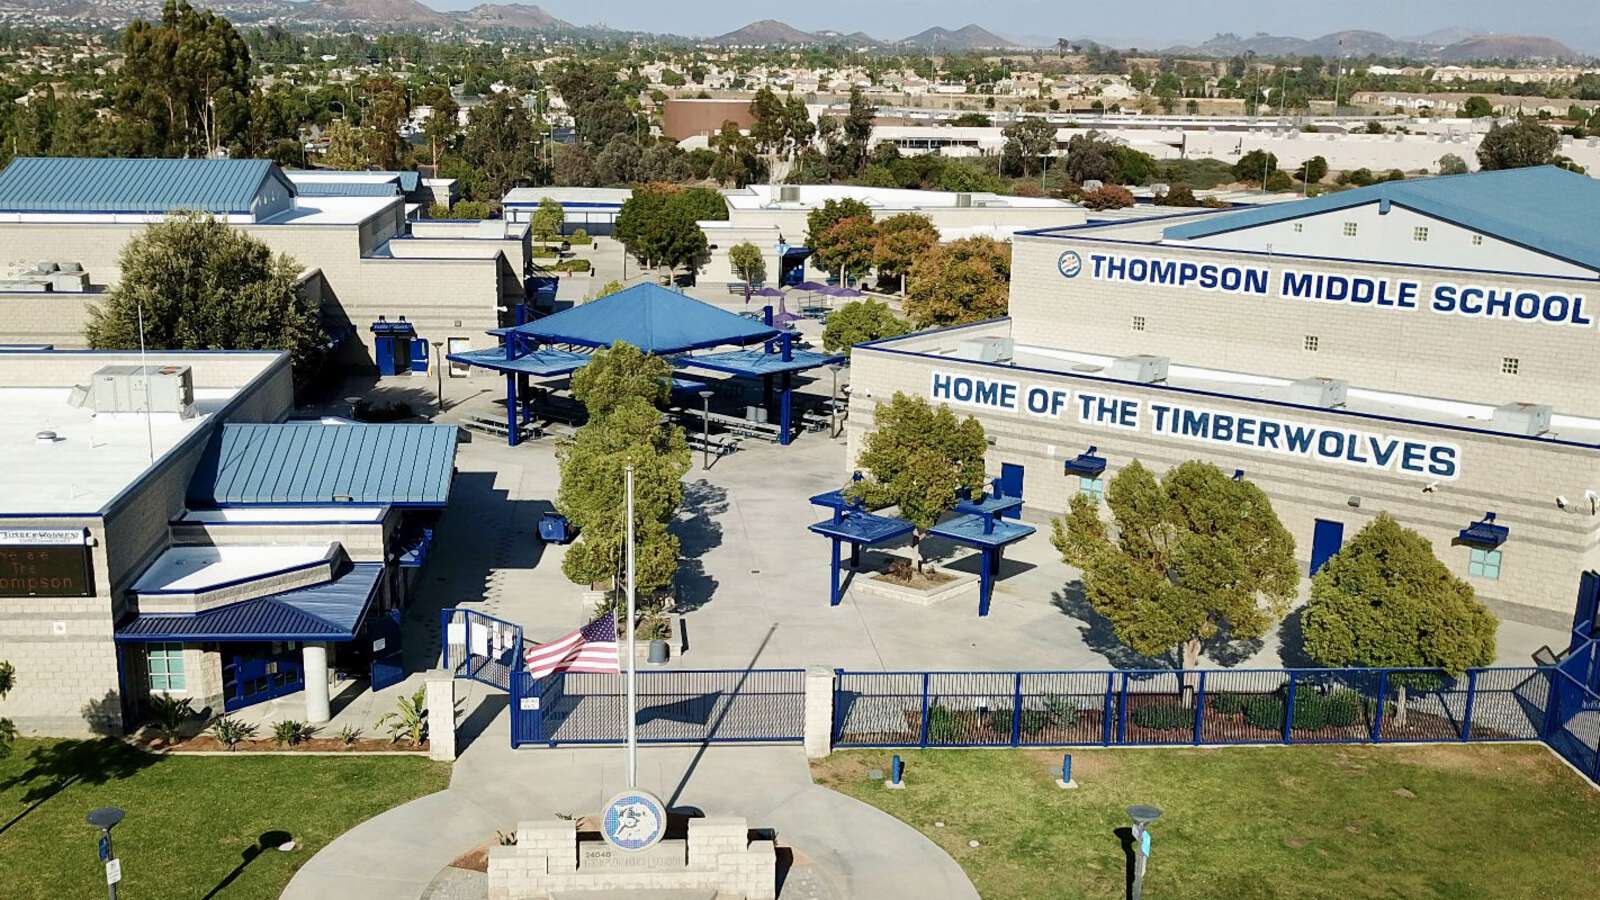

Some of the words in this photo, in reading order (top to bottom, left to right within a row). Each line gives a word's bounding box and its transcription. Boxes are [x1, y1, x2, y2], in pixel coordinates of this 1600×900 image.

[1091, 254, 1268, 294] THOMPSON
[1282, 272, 1418, 308] MIDDLE
[1433, 286, 1591, 325] SCHOOL
[933, 374, 1017, 409] HOME
[1028, 388, 1067, 416] OF
[1079, 394, 1138, 427] THE
[1152, 405, 1456, 477] TIMBERWOLVES
